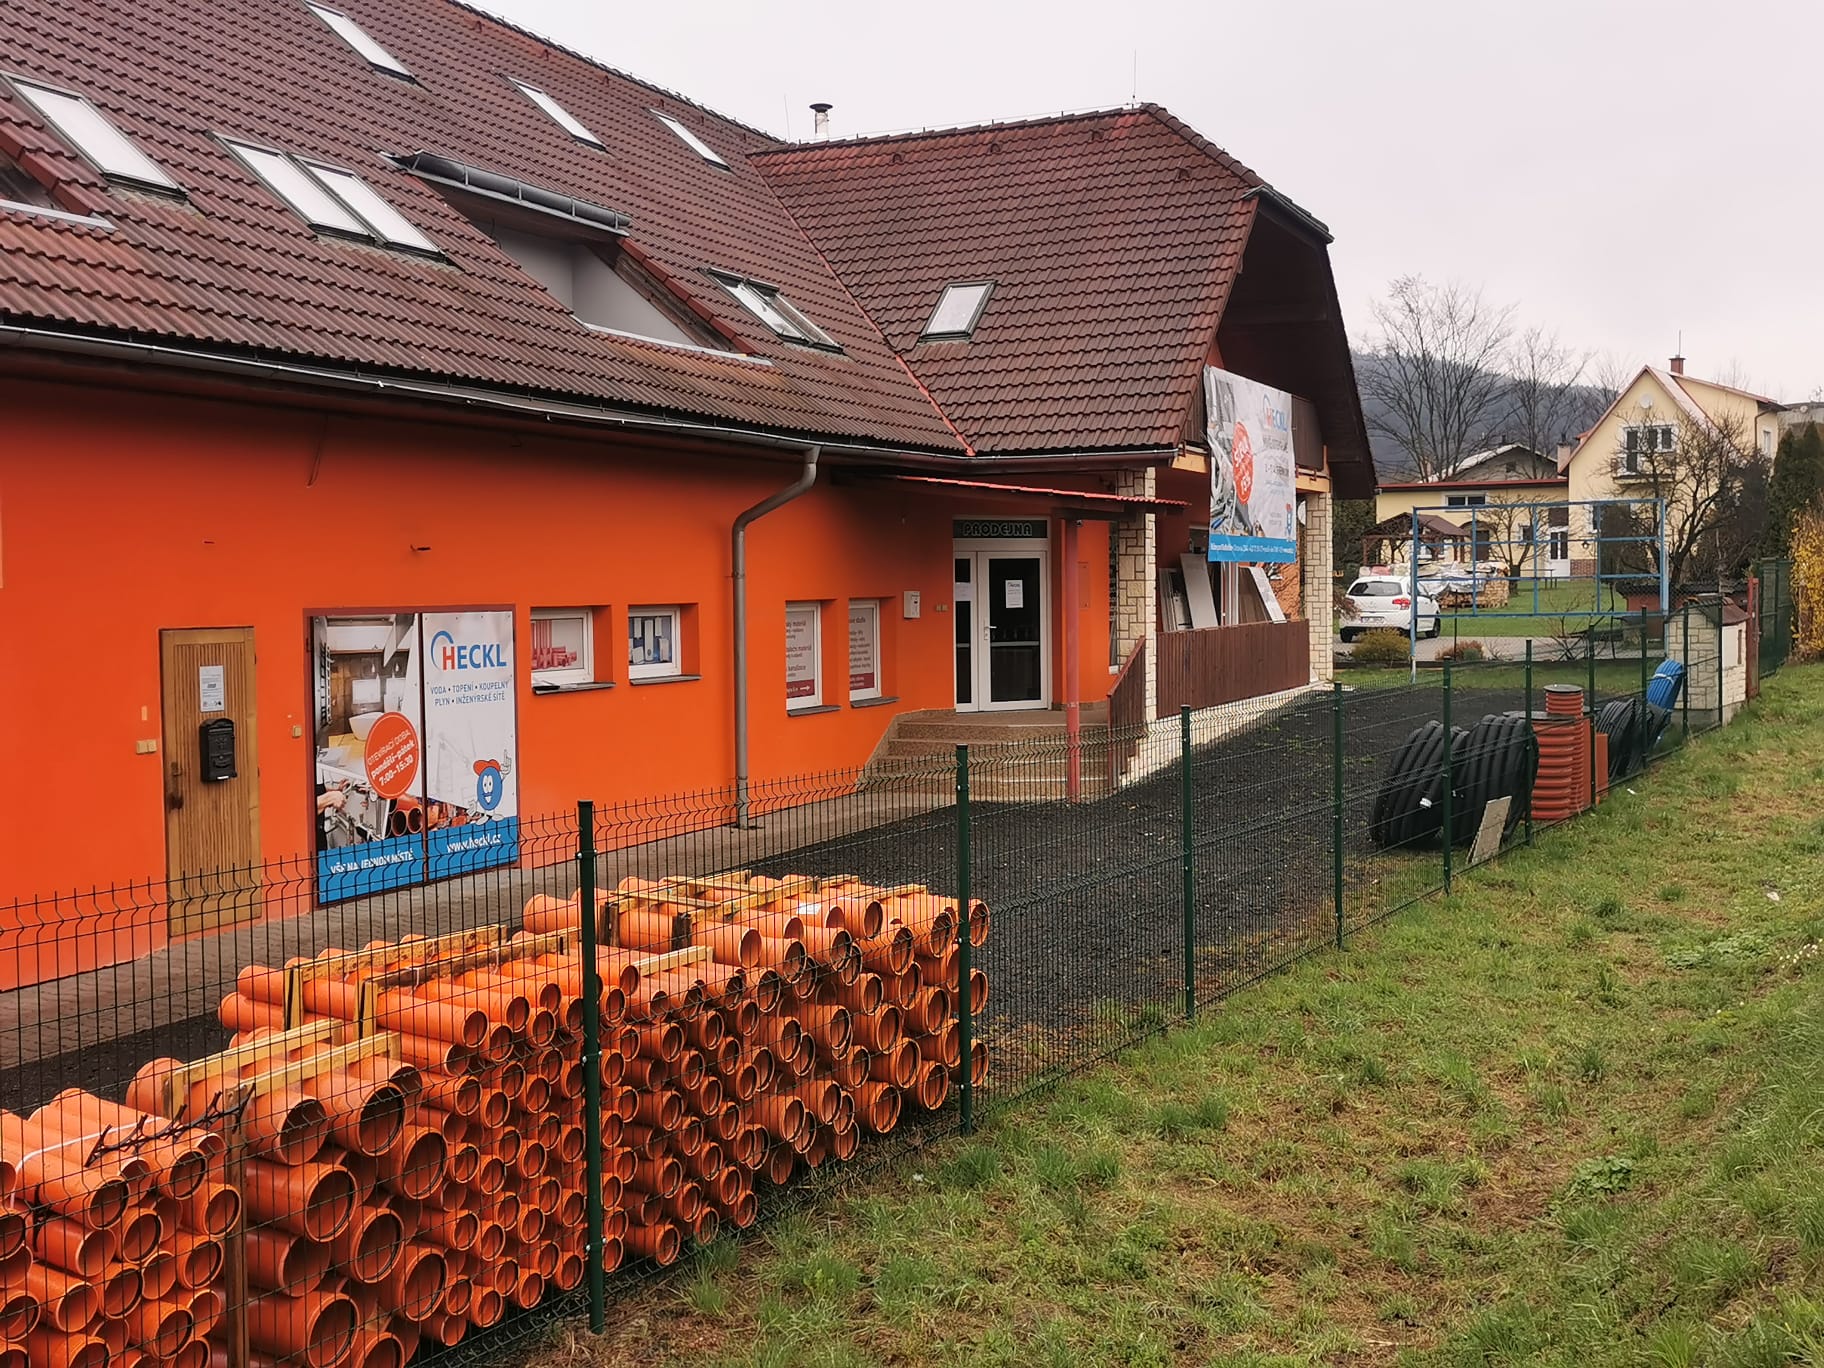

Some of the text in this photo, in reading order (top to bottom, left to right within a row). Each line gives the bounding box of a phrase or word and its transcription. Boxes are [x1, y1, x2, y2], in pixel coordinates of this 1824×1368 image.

[963, 522, 1033, 537] PRODEJNA
[442, 643, 507, 671] HECKL
[431, 680, 509, 695] VODA TOPENÍ KOUPELNY
[434, 697, 450, 706] PLYN
